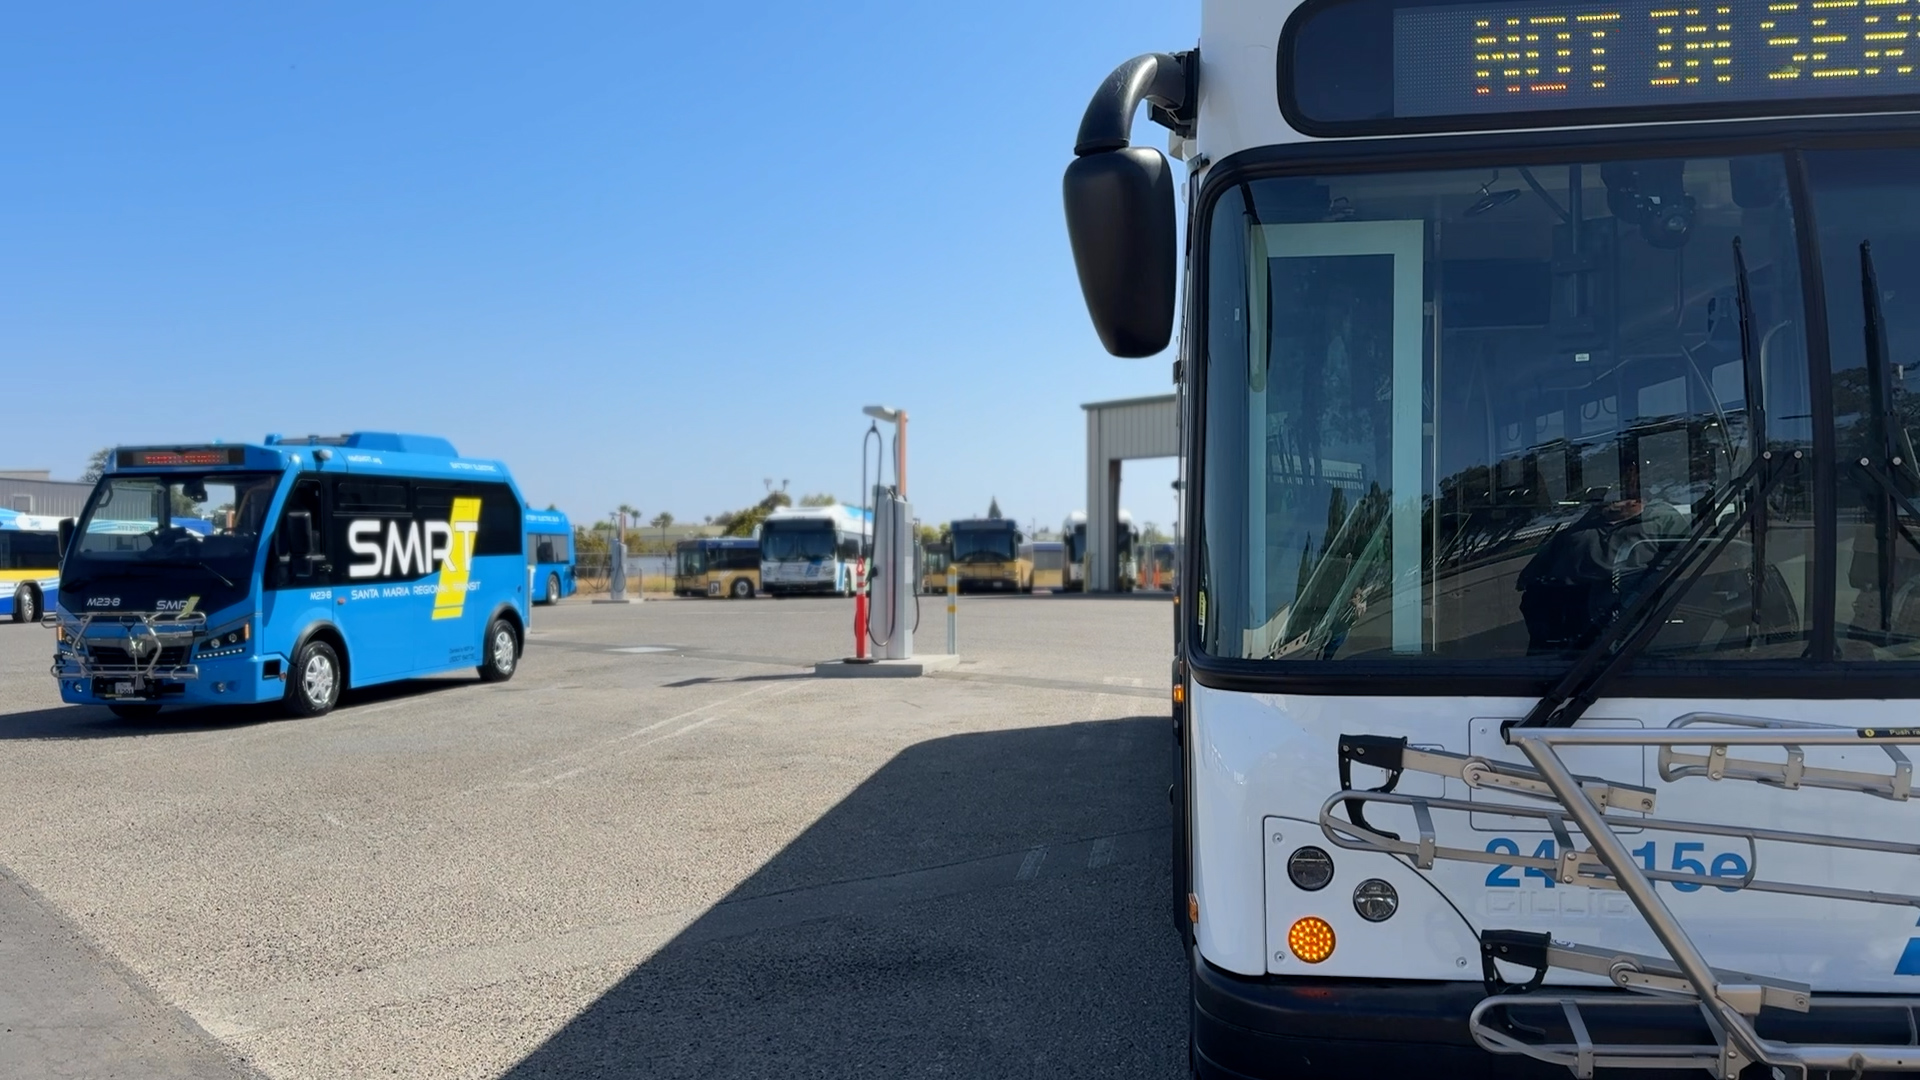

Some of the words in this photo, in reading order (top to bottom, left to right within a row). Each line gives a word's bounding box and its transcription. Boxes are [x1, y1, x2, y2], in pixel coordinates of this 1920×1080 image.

[1476, 14, 1620, 94] NOT
[1651, 7, 1731, 85] IN
[1761, 0, 1920, 78] SER
[348, 520, 478, 578] SMRT
[156, 600, 197, 611] SMR
[351, 588, 380, 600] SANTA
[383, 586, 410, 598] MARIA
[413, 584, 449, 595] REGIONAL
